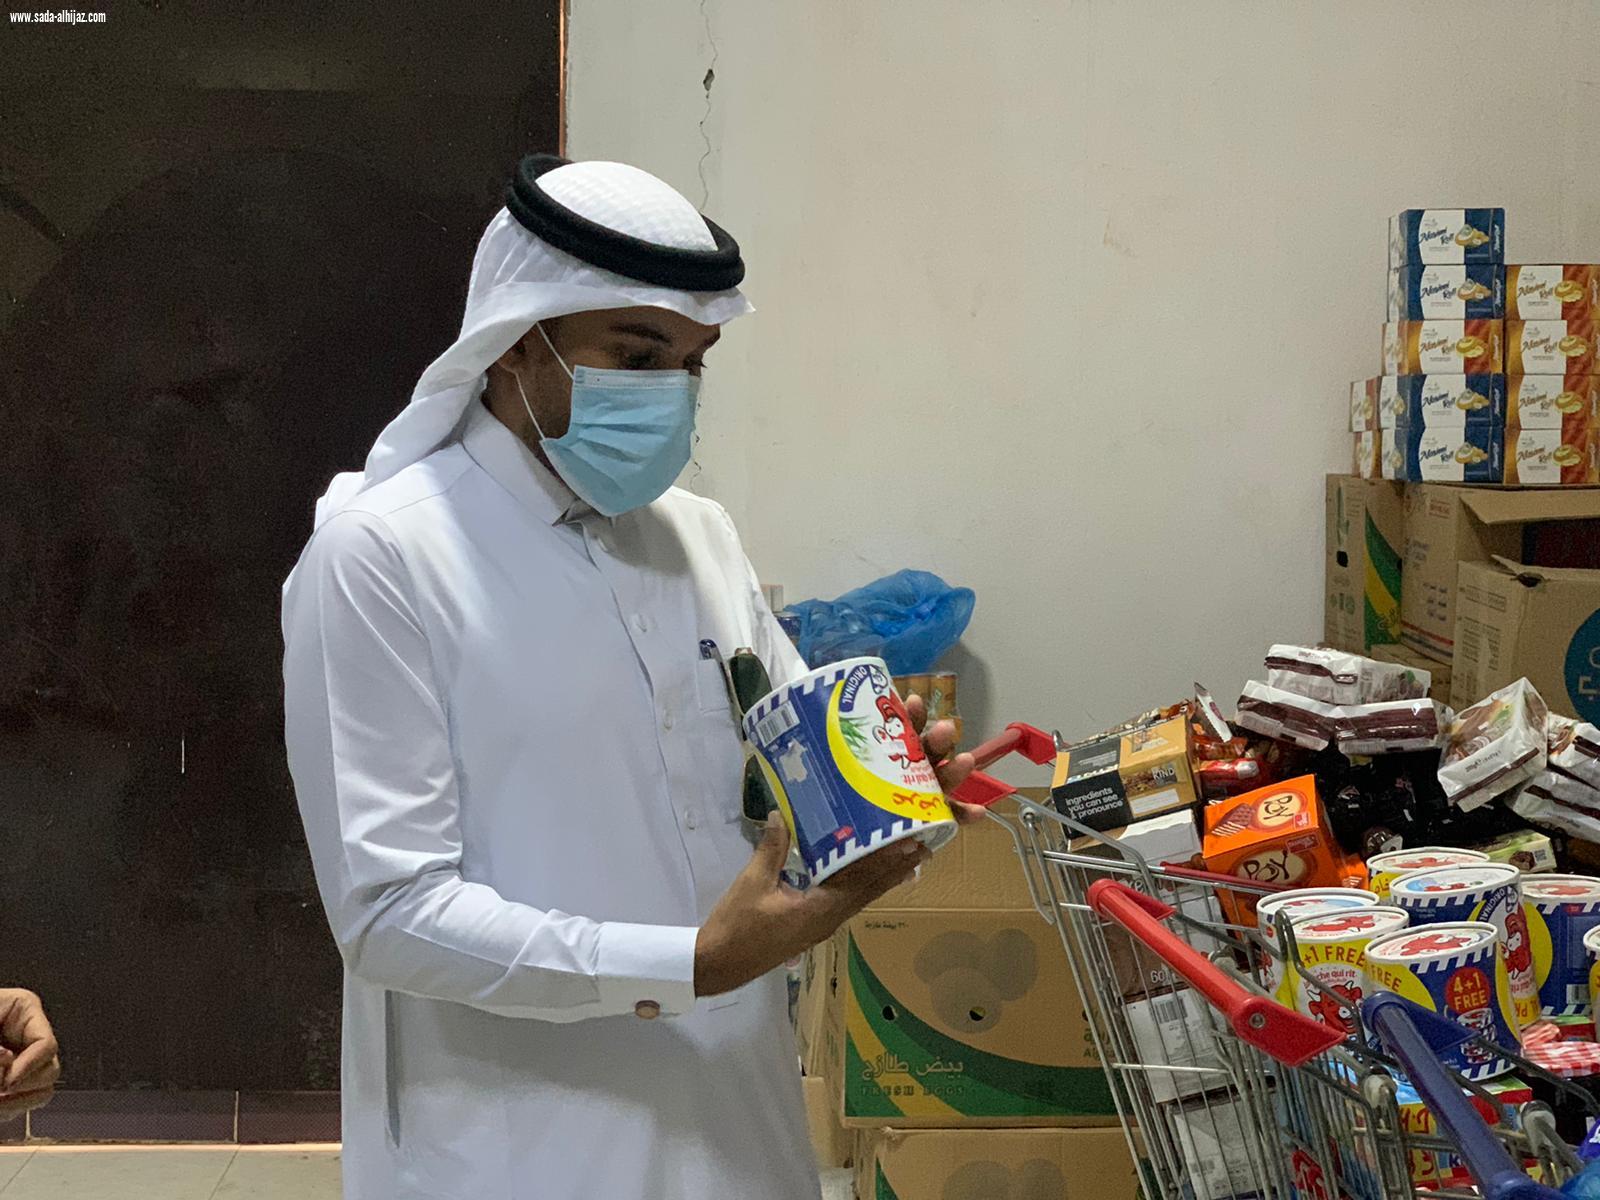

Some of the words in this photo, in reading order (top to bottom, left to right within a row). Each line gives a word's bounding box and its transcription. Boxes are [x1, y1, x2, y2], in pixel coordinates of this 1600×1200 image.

[842, 666, 868, 704] ORIGINAL
[1068, 804, 1085, 814] you
[1085, 799, 1102, 808] can
[1102, 794, 1118, 803] see
[1078, 800, 1123, 820] pronounce
[1480, 888, 1505, 921] ORIGINAL
[1301, 945, 1319, 967] +1
[1325, 945, 1365, 968] FREE
[1453, 971, 1482, 993] 4+1
[1454, 990, 1488, 1011] FREE
[861, 1052, 909, 1081] طازج
[916, 1056, 964, 1079] بيض
